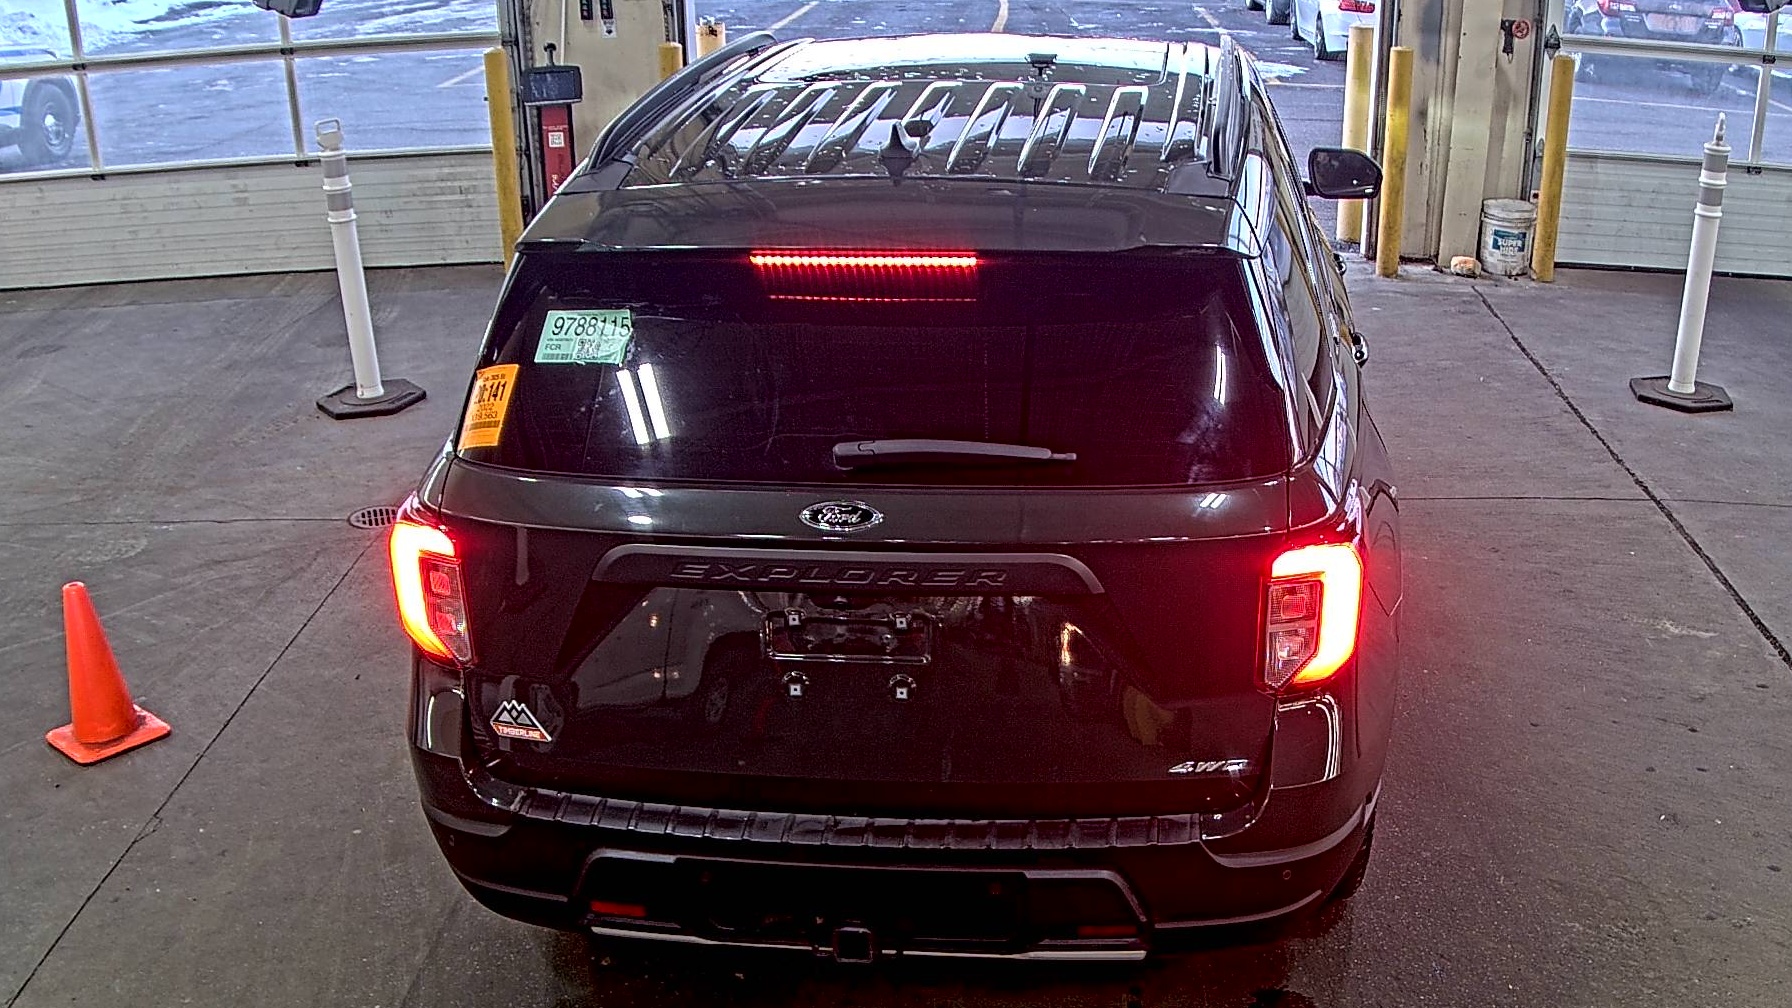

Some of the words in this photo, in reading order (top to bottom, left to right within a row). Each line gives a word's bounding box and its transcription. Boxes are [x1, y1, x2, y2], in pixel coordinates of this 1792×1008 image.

[552, 316, 631, 338] 9788115
[545, 343, 562, 351] FCR
[669, 563, 1008, 587] EXPLORER
[498, 726, 541, 738] TIMBERLINE
